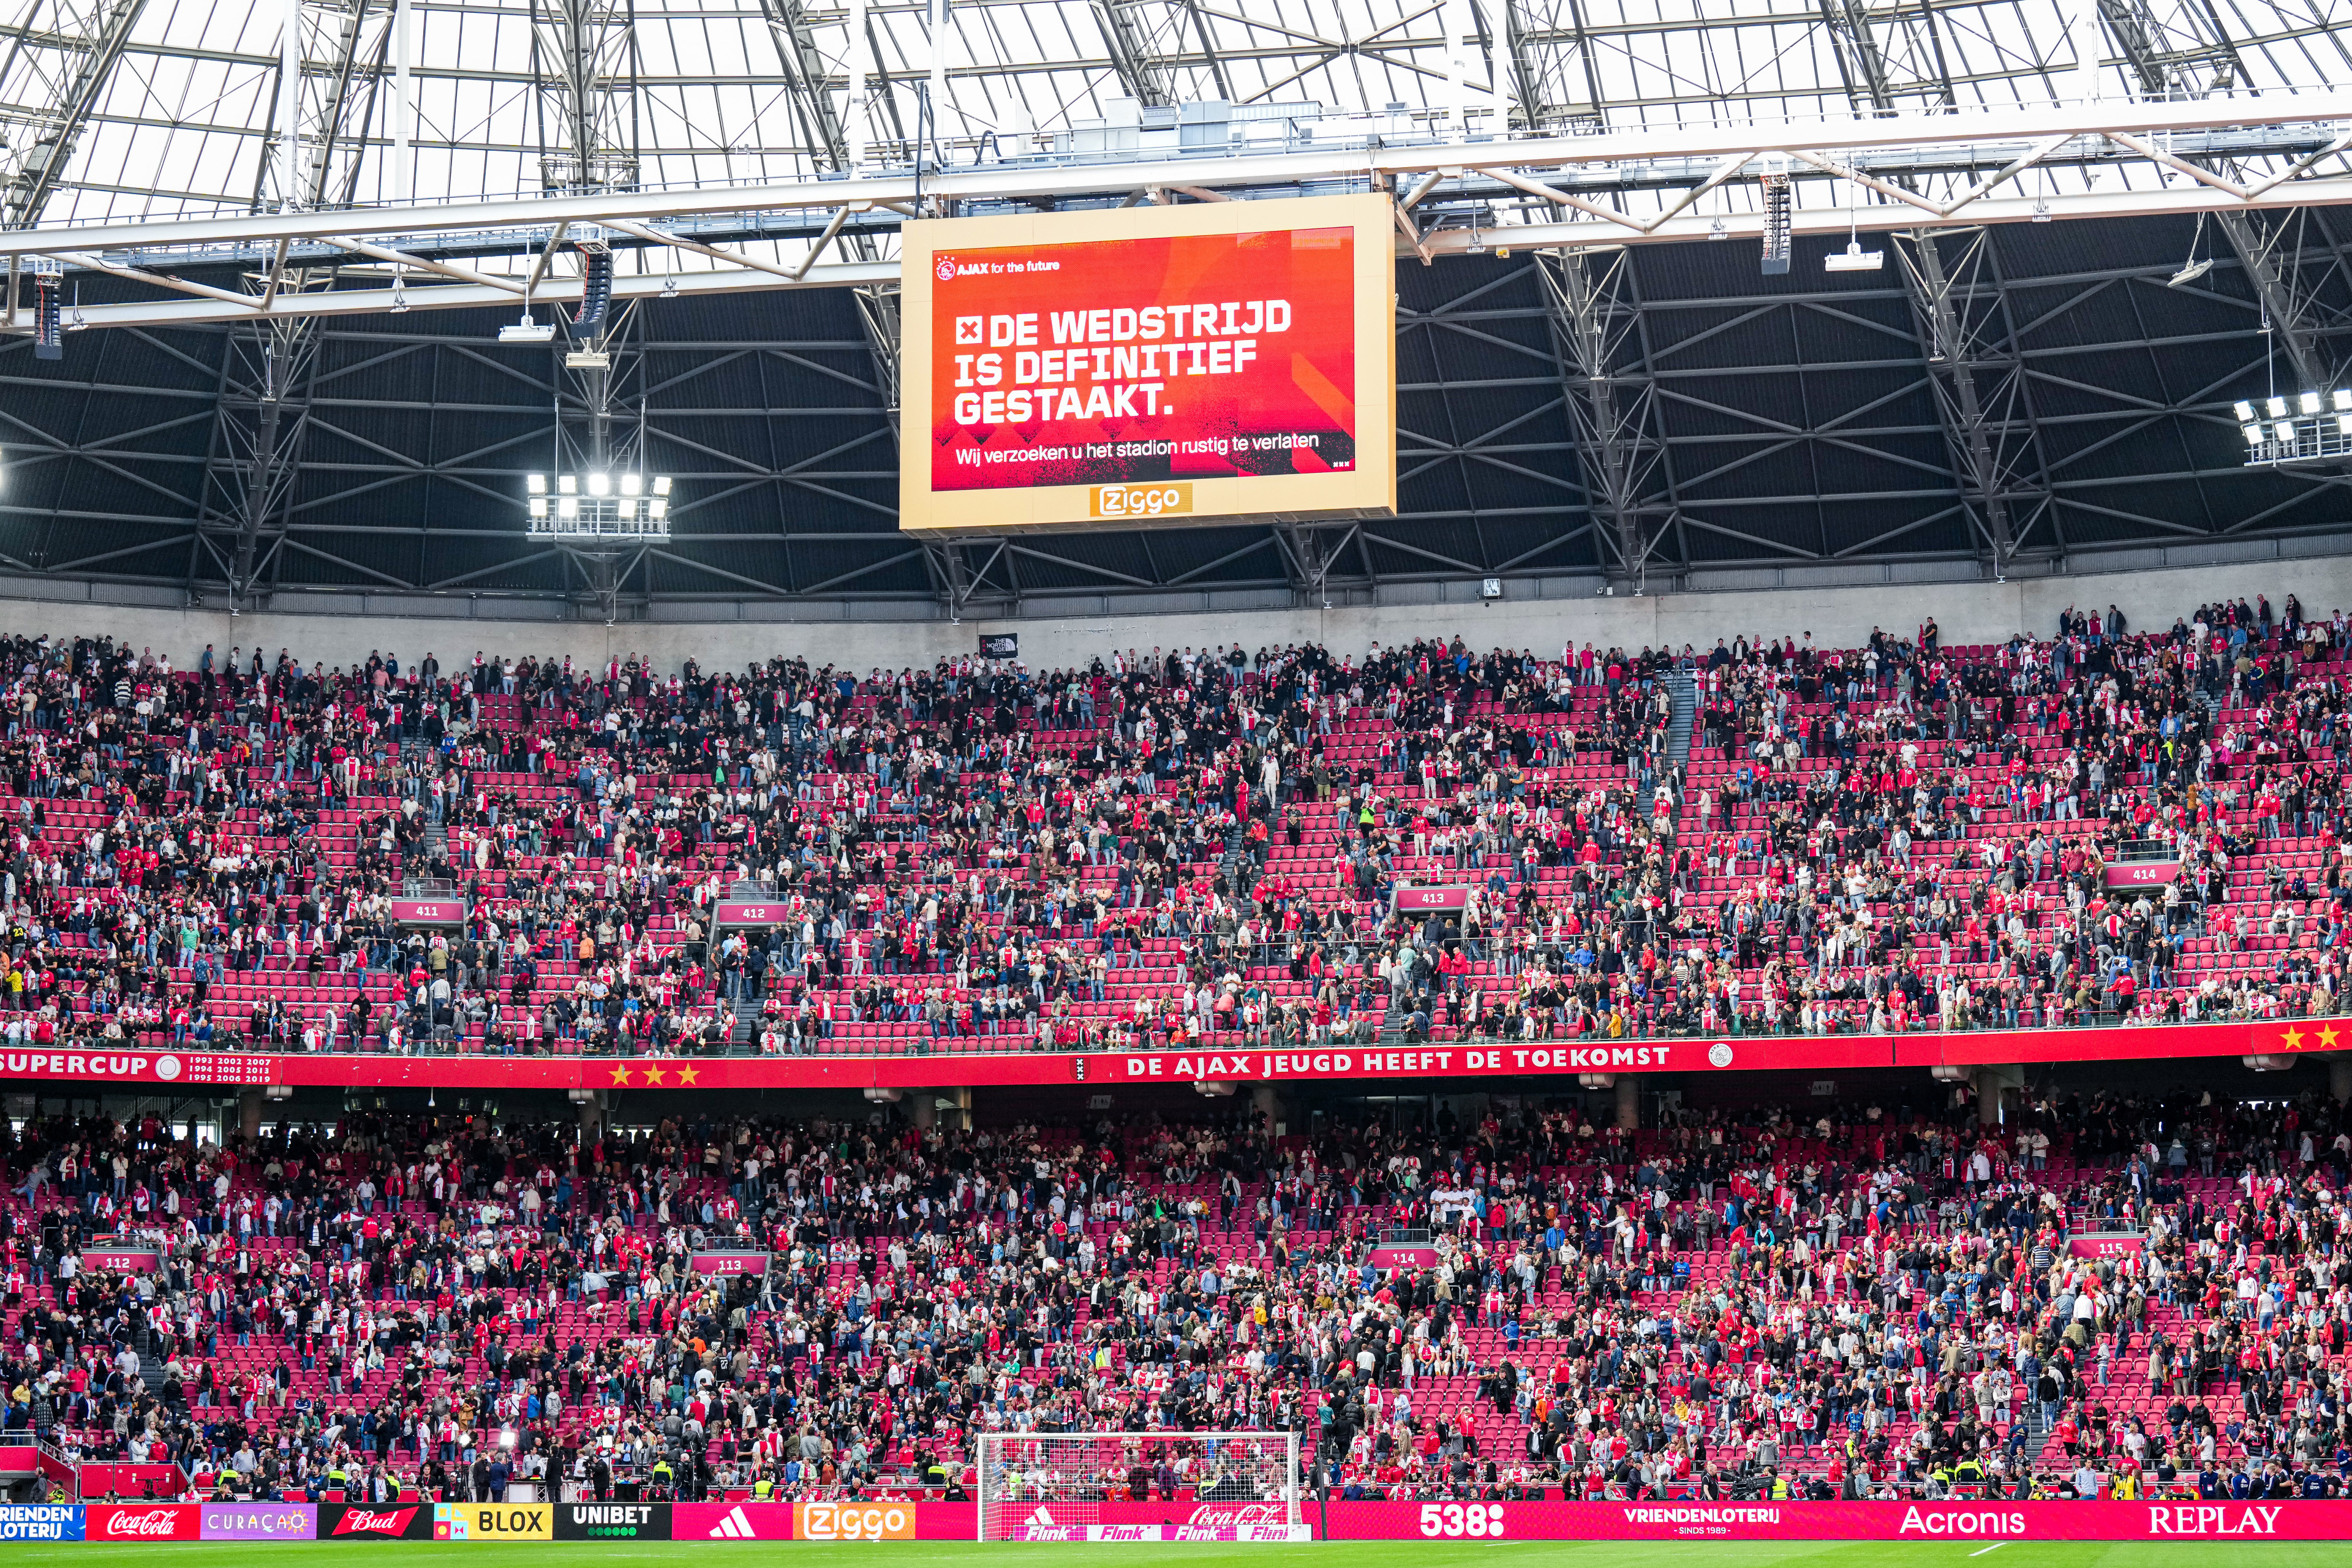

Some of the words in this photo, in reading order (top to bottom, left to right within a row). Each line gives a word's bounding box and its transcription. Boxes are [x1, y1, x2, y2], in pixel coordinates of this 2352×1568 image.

[957, 263, 989, 275] AJAX
[991, 263, 1005, 273] for
[1007, 262, 1024, 273] the
[1027, 261, 1060, 271] future
[990, 313, 1038, 347] DE
[1050, 300, 1291, 343] WEDSTRIJD
[955, 353, 1002, 387] IS
[1016, 339, 1256, 385] DEFINITIEF
[955, 382, 1172, 424] GESTAAKT.
[956, 448, 980, 467] Wij
[984, 445, 1068, 462] verzoeken
[1072, 447, 1082, 459] u
[1087, 443, 1113, 458] het
[1117, 440, 1177, 457] stadion
[1182, 437, 1227, 455] rustig
[1232, 436, 1249, 451] te
[1252, 432, 1319, 450] verlaten
[2133, 869, 2156, 880] 414
[1422, 893, 1444, 903] 413
[417, 906, 439, 916] 411
[742, 908, 765, 918] 412
[13, 927, 23, 937] 23
[1128, 1058, 1162, 1076] DE
[1174, 1057, 1251, 1079] AJAX
[1262, 1054, 1352, 1078] JEUGD
[1363, 1052, 1452, 1071] HEEFT
[1466, 1051, 1501, 1069] DE
[1512, 1047, 1670, 1068] TOEKOMST
[2099, 1243, 2123, 1254] 115
[106, 1257, 130, 1268] 112
[718, 1260, 741, 1270] 113
[1392, 1253, 1415, 1263] 114
[721, 1360, 728, 1370] 27
[1354, 1444, 1362, 1453] 60
[0, 1507, 73, 1521] RIENDEN
[349, 1509, 396, 1530] Bud
[573, 1506, 652, 1524] UNIBET
[1624, 1509, 1779, 1524] VRIENDENLOTERIJ
[1899, 1506, 2025, 1533] Acronis
[2149, 1507, 2282, 1533] REPLAY
[107, 1510, 178, 1535] Coca-Cola
[208, 1513, 304, 1533] CURAÇAO
[480, 1511, 543, 1532] BLOX
[1025, 1528, 1070, 1541] Flink
[1099, 1526, 1145, 1540] Flink
[1174, 1526, 1221, 1541] Flink
[1250, 1526, 1287, 1540] Flin
